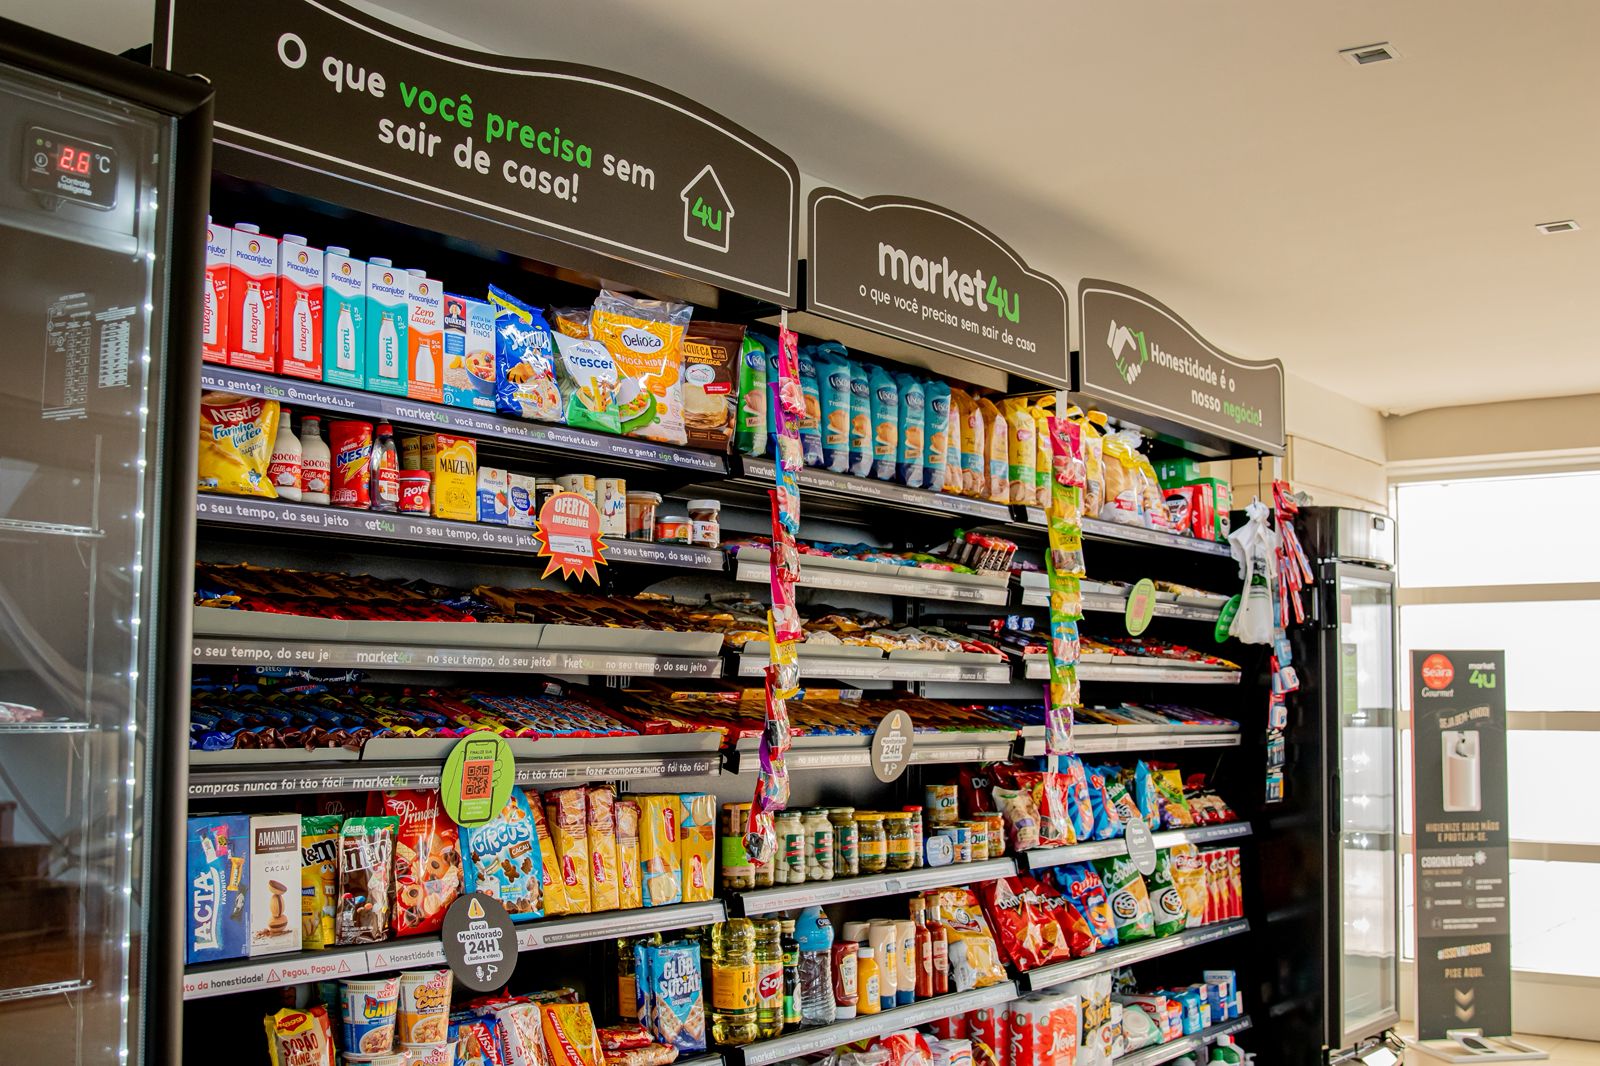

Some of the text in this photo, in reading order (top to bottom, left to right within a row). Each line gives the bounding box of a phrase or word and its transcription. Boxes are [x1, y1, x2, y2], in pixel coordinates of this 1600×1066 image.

[278, 33, 656, 190] O que você precisa sem
[60, 147, 90, 174] 2.6
[378, 116, 580, 203] sair de casa!
[692, 196, 722, 232] 4u
[236, 250, 272, 265] Piracanjuba
[287, 261, 319, 276] Piracanjuba
[331, 272, 362, 287] Piracanjuba
[878, 242, 1019, 324] market4u
[372, 283, 406, 296] Piracanjuba
[408, 293, 438, 306] Piracanjuba
[415, 306, 434, 318] Zero
[859, 284, 1036, 353] o que você precisa sem sair de casa
[249, 302, 262, 344] integral
[411, 315, 436, 326] Lactose
[444, 316, 466, 327] QUAKER
[470, 322, 492, 332] FLOCOS
[299, 312, 310, 352] integral
[473, 330, 490, 338] FINOS
[340, 328, 350, 360] semi
[622, 334, 662, 348] Delioca
[382, 336, 392, 367] semi
[570, 355, 613, 370] crescer
[1150, 342, 1235, 392] Honestidade é o
[228, 380, 261, 394] gente?
[288, 386, 355, 408] @market4u.br
[210, 402, 260, 422] Nestlé
[1192, 388, 1262, 428] nosso negócio!
[213, 422, 254, 440] Farinha
[396, 406, 449, 424] market4u
[454, 417, 473, 429] você
[476, 420, 492, 430] ama
[503, 426, 527, 437] gente?
[548, 430, 599, 448] @market4u.br
[612, 444, 627, 453] ama
[635, 449, 656, 458] gente?
[440, 458, 475, 475] MAIZENA
[211, 504, 349, 528] seu tempo, do seu jeito
[555, 498, 589, 518] OFERTA
[552, 514, 589, 528] IMPERDÍVEL
[410, 524, 536, 546] no seu tempo, do seu jeito
[640, 548, 666, 561] tempo,
[668, 551, 678, 559] do
[680, 553, 693, 562] seu
[694, 553, 711, 564] jeito
[206, 646, 316, 661] seu tempo, do seu
[427, 654, 439, 663] no
[442, 655, 460, 665] seu
[463, 654, 495, 667] tempo,
[498, 656, 510, 666] do
[513, 658, 528, 667] seu
[530, 656, 551, 668] jeito
[634, 661, 661, 672] tempo,
[664, 662, 673, 671] do
[675, 664, 688, 672] seu
[690, 662, 707, 673] jeito
[1423, 668, 1452, 677] Seara
[1422, 687, 1454, 697] Gourmet
[885, 745, 900, 754] 24H
[518, 768, 567, 780] foi tão fácil
[585, 766, 607, 776] fazer
[609, 766, 641, 777] compras
[643, 766, 665, 774] nunca
[679, 762, 692, 772] tão
[694, 762, 709, 772] fácil
[189, 775, 408, 795] compras nunca foi tão fácil market4u
[1426, 823, 1459, 832] HIGIENIZE
[1462, 822, 1479, 831] SUAS
[258, 829, 295, 846] AMANDITA
[474, 822, 531, 853] CIRCUS
[511, 844, 531, 856] CACAU
[1421, 854, 1474, 868] CORONAVÍRUS
[194, 869, 219, 952] LACTA
[459, 930, 502, 941] Monitorado
[469, 941, 496, 954] 24H
[390, 950, 435, 963] Honestidade
[211, 974, 264, 988] honestidade!
[282, 968, 309, 979] Pegou,
[311, 964, 336, 976] Pagou
[663, 957, 694, 979] CLUB
[660, 972, 700, 998] SOCIAL
[1047, 1030, 1075, 1055] Neve
